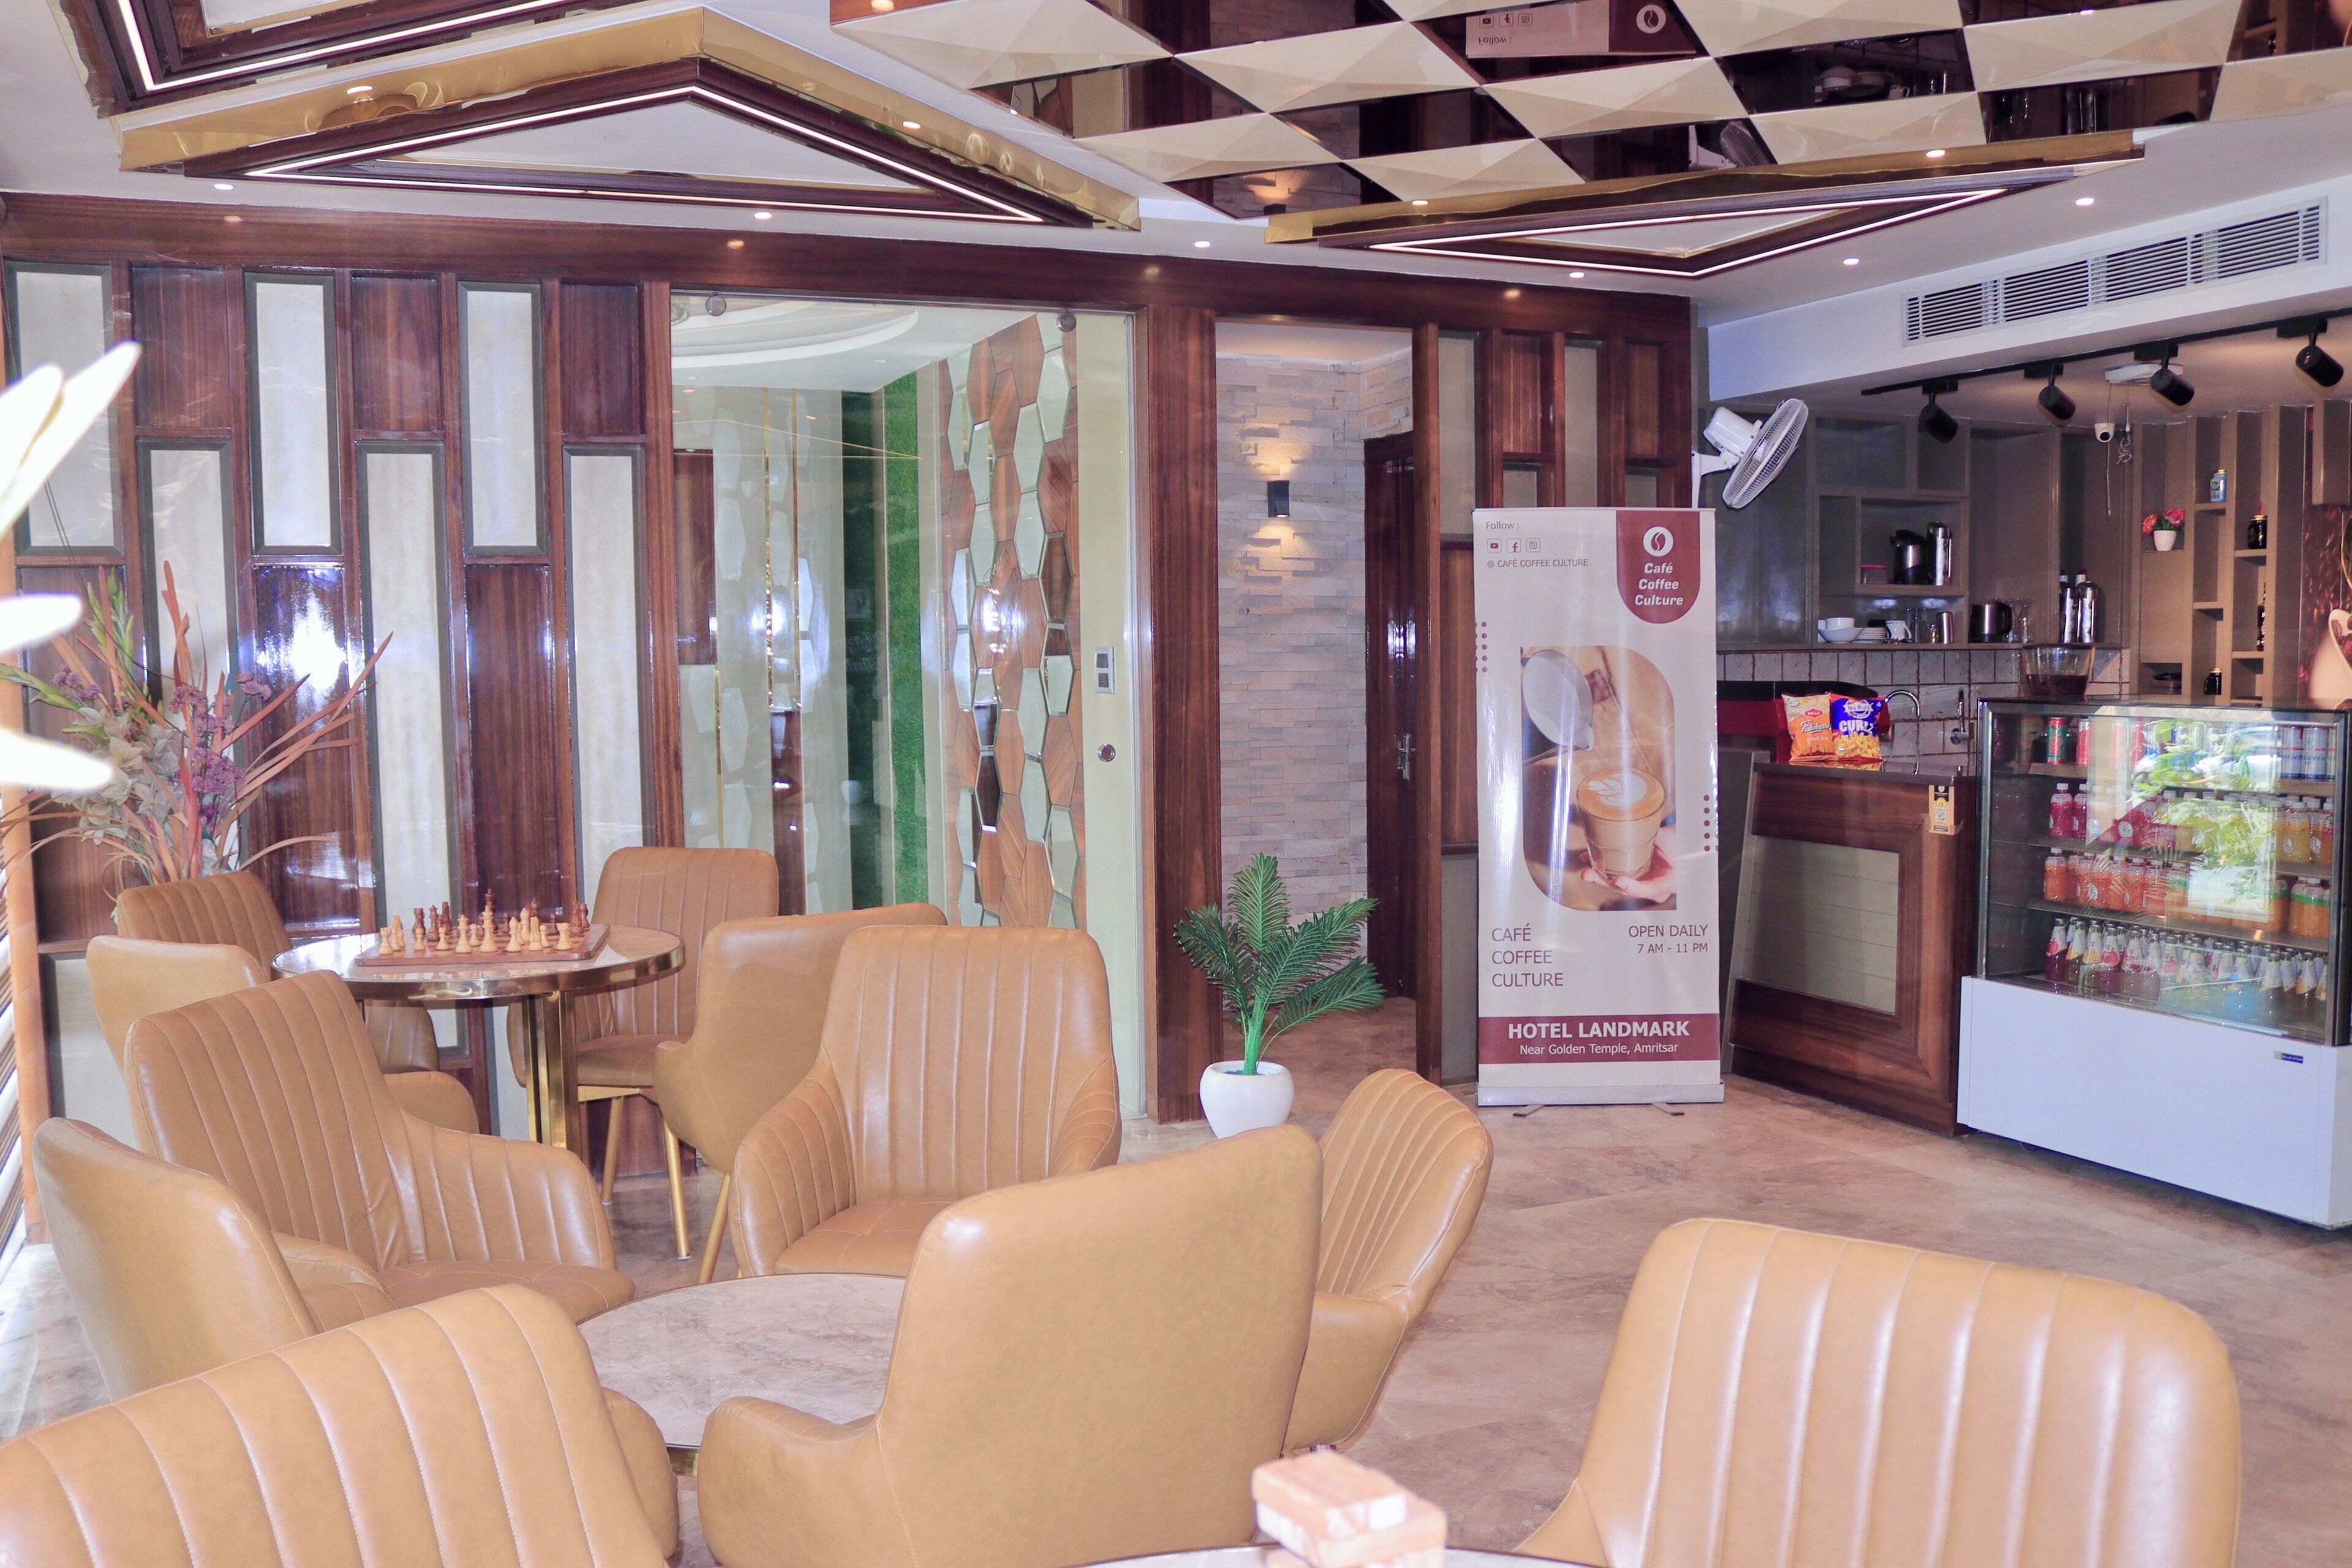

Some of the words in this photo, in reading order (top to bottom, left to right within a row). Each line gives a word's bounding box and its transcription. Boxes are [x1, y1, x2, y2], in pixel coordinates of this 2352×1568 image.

[1487, 560, 1495, 569] @
[1497, 558, 1518, 567] CAFÉ
[1553, 559, 1588, 567] CULTURE
[1644, 562, 1673, 573] Café
[1638, 578, 1679, 589] Coffee
[1635, 594, 1684, 605] Culture
[1491, 922, 1531, 941] CAFÉ
[1629, 925, 1664, 937] OPEN
[1670, 924, 1708, 937] DAILY
[1637, 944, 1645, 954] 7
[1647, 943, 1664, 953] AM
[1676, 943, 1689, 953] 11
[1692, 943, 1708, 952] PM
[1492, 950, 1553, 965] COFFEE
[1492, 973, 1564, 987] CULTURE
[1508, 1022, 1573, 1039] HOTEL
[1578, 1020, 1690, 1038] LANDMARK
[1520, 1044, 1545, 1055] Near
[1548, 1043, 1586, 1054] Golden
[1589, 1043, 1630, 1055] Temple,
[1634, 1042, 1679, 1053] Amritsar
